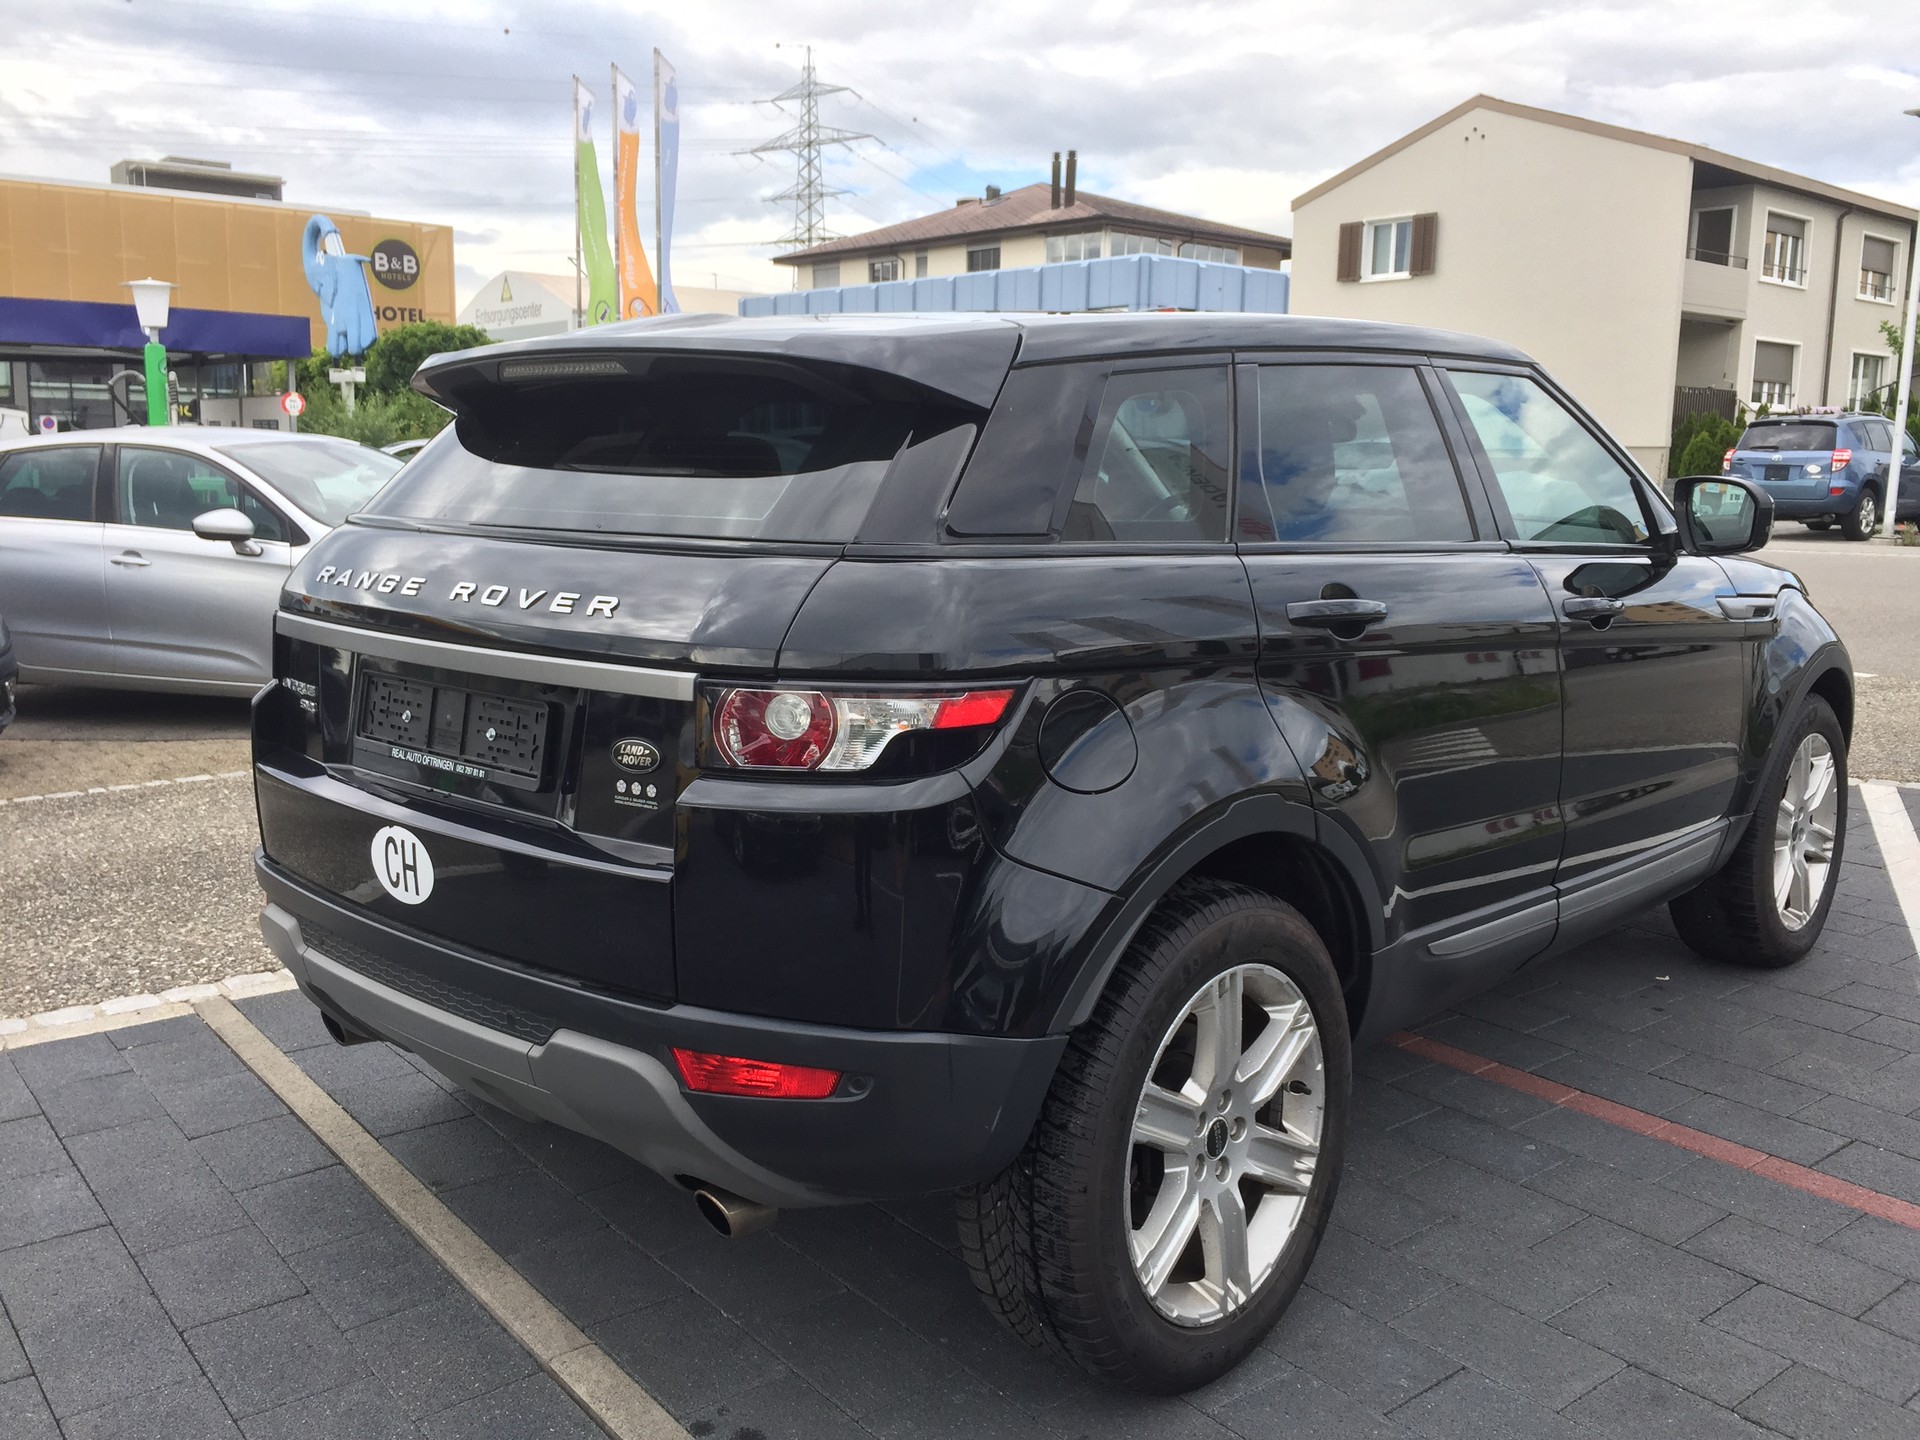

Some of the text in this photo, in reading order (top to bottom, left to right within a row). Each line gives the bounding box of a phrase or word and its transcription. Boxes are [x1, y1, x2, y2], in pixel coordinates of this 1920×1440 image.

[374, 252, 418, 274] B&B
[381, 272, 412, 281] HOTELS
[475, 302, 543, 327] Entsorgungscenter
[315, 565, 621, 618] RANGE ROVER
[620, 744, 645, 756] LAND
[622, 755, 652, 767] ROVER
[391, 747, 406, 760] REAL
[405, 751, 422, 764] AUTO
[422, 755, 455, 772] OFTRINGEN
[464, 766, 473, 775] 797
[472, 768, 479, 777] 81
[479, 770, 485, 778] 81
[385, 836, 420, 896] CH
